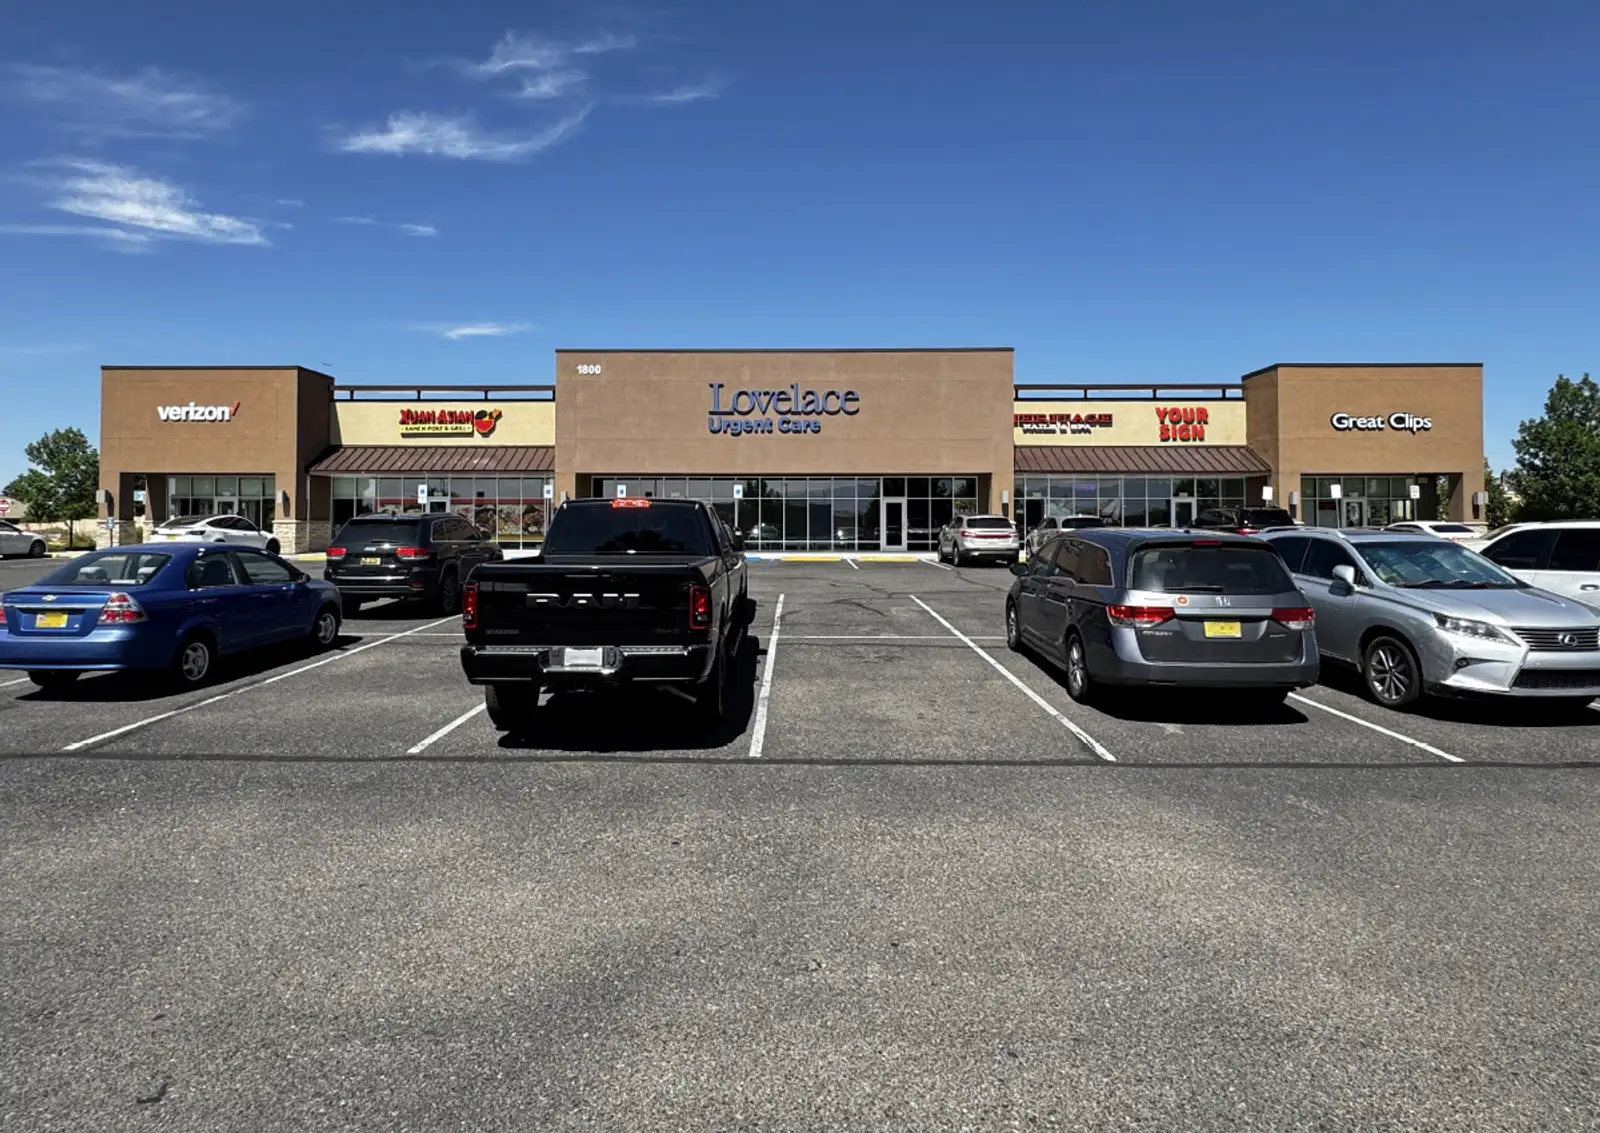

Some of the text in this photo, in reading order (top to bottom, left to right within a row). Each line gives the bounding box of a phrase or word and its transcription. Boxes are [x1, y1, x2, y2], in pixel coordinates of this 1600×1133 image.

[576, 364, 602, 375] 1800
[708, 382, 860, 415] Lovelace
[157, 401, 231, 422] verizon
[1155, 407, 1209, 424] YOUR
[708, 416, 821, 436] Urgent Care
[1159, 424, 1205, 442] SIGN
[1330, 412, 1433, 434] Great Clips
